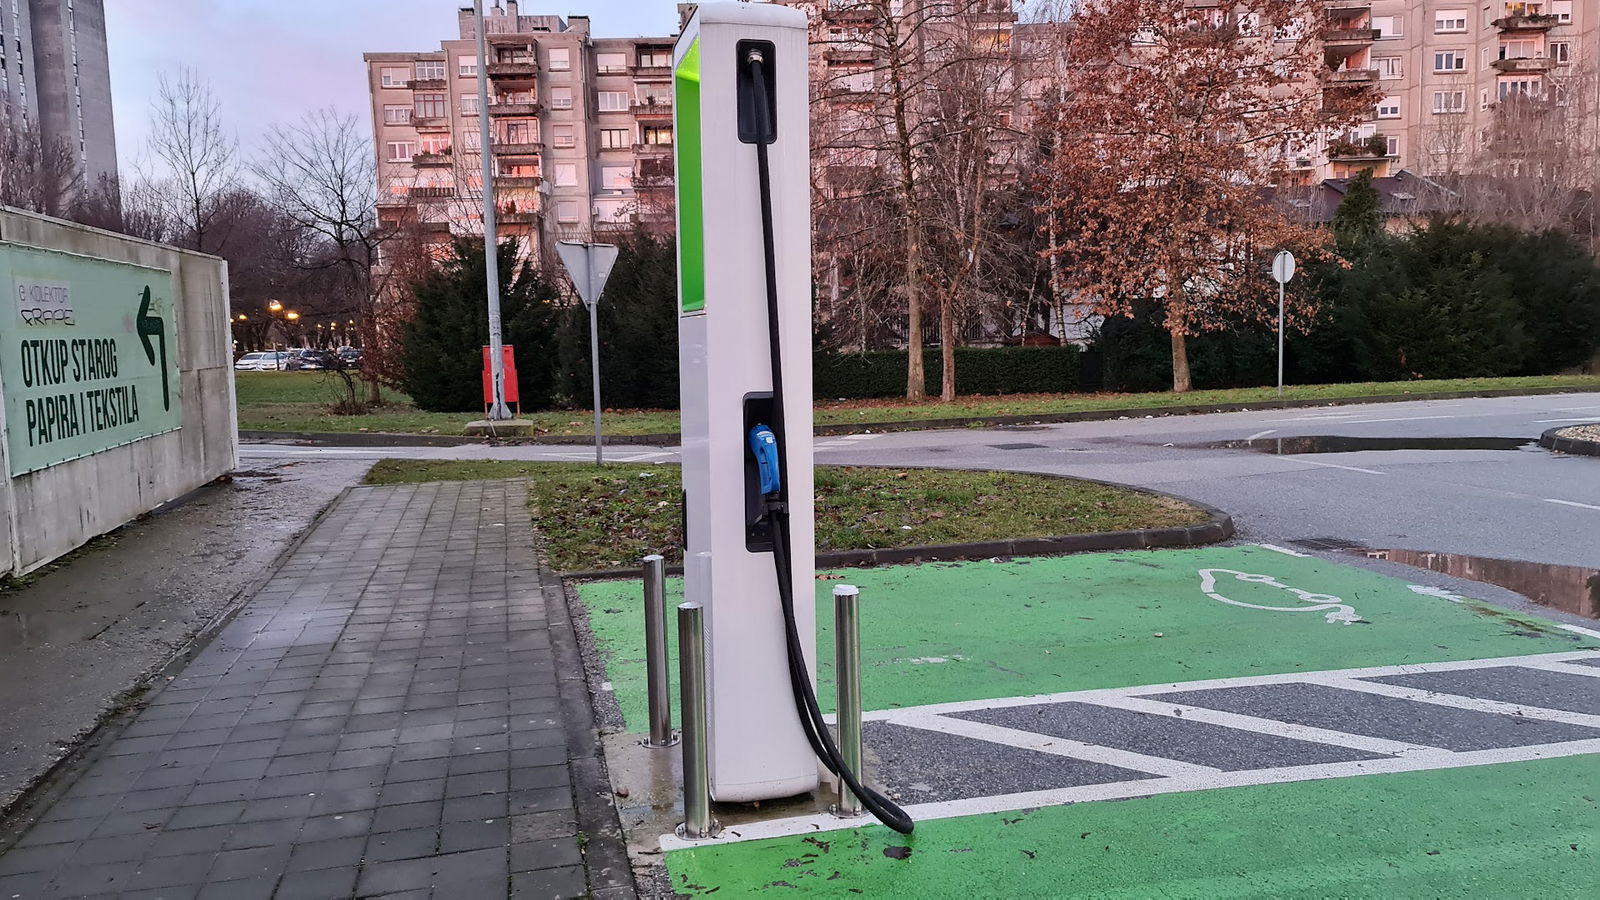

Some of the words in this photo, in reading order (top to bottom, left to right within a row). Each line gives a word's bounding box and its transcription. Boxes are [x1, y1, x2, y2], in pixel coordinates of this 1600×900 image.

[21, 339, 68, 387] OTKUP
[72, 338, 117, 382] STAROG
[26, 394, 80, 447] PAPIRA
[80, 392, 86, 434] I
[87, 385, 139, 432] TEKSTILA
